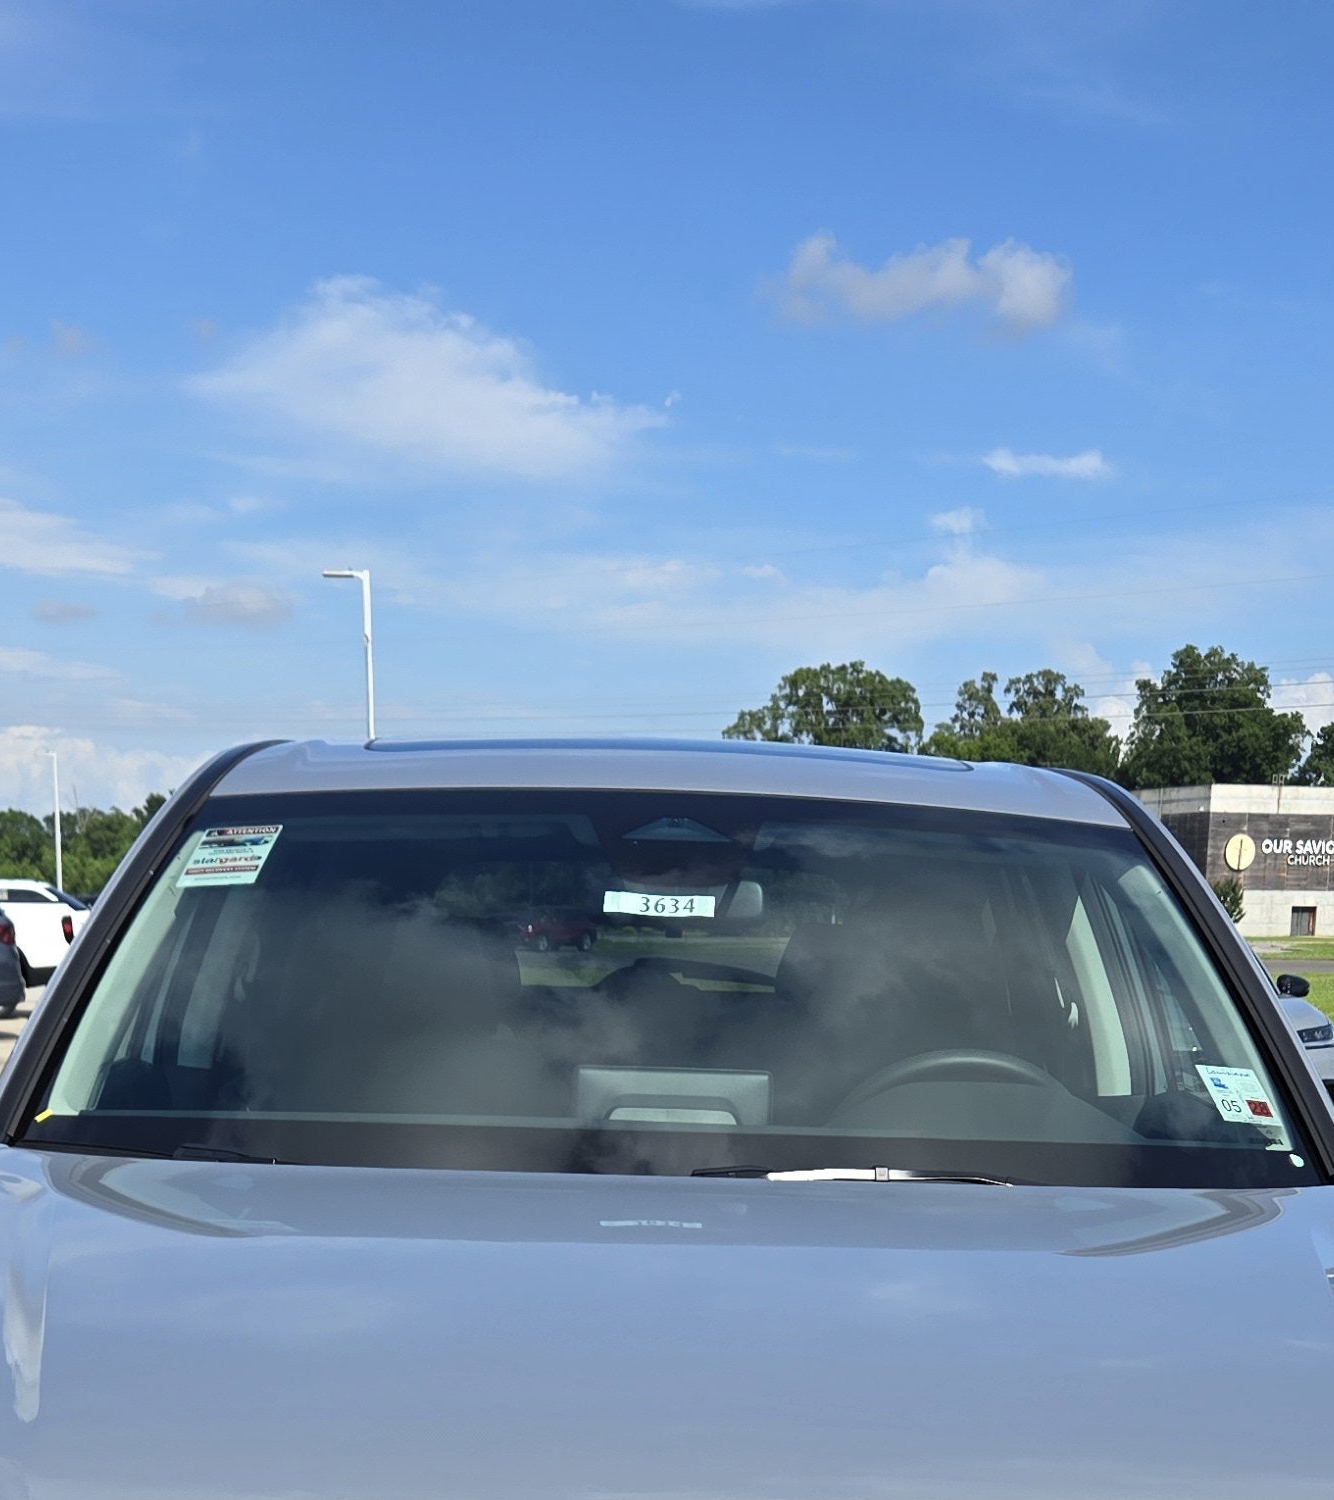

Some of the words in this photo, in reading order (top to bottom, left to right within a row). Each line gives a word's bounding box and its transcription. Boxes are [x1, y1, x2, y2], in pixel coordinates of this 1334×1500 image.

[1261, 838, 1293, 854] OUR
[1287, 854, 1331, 867] CHURCH
[639, 896, 696, 913] 3634
[1221, 1098, 1243, 1113] 05
